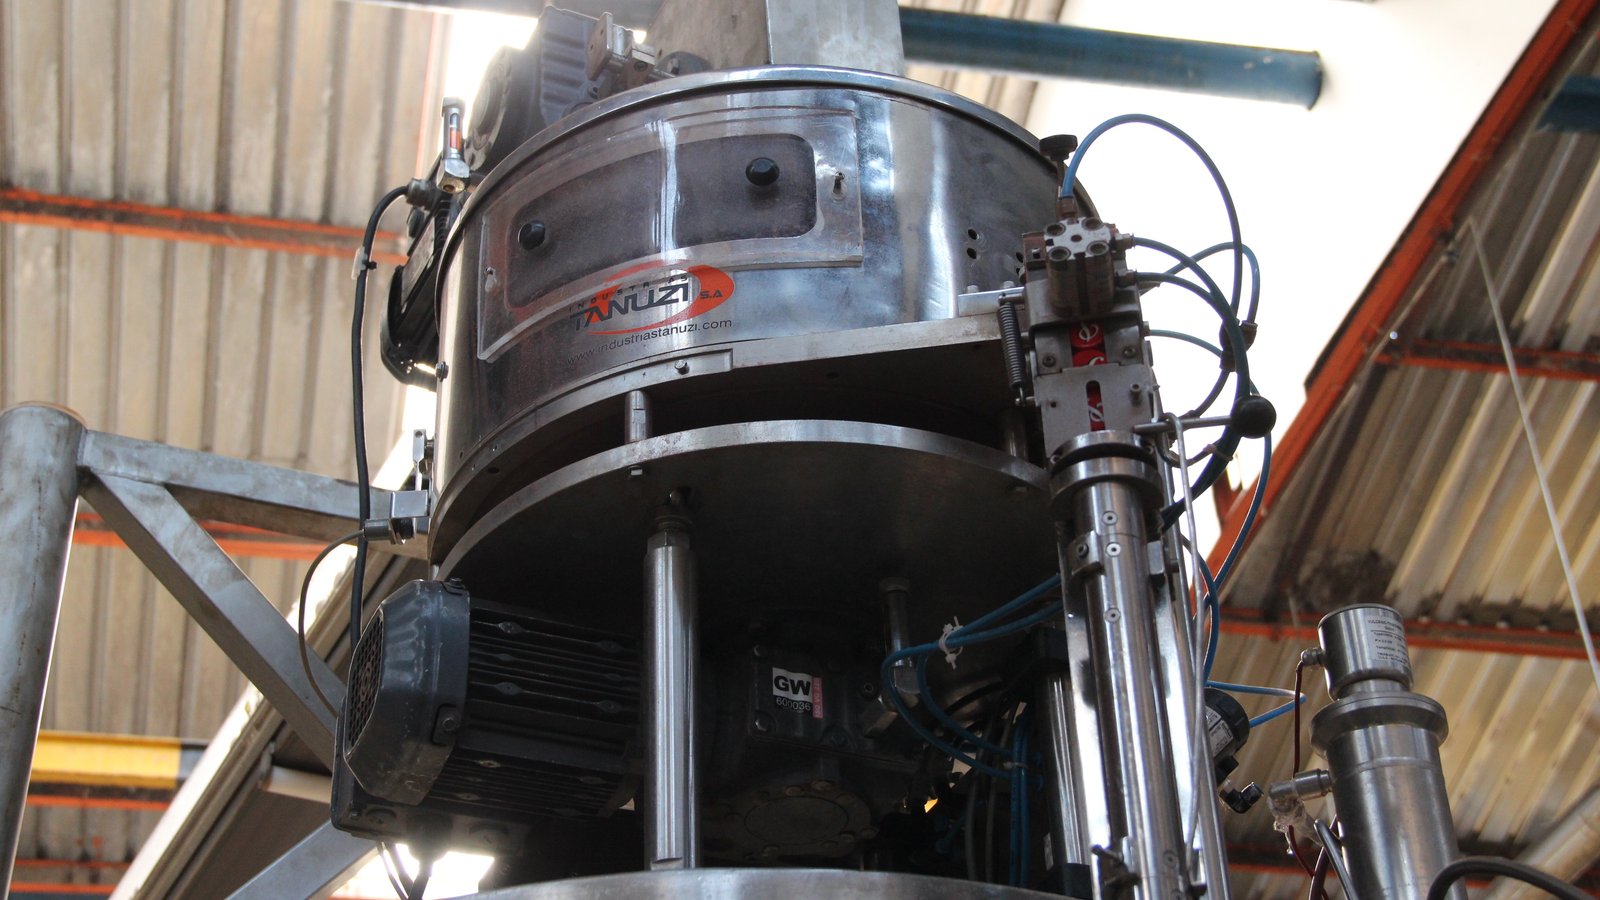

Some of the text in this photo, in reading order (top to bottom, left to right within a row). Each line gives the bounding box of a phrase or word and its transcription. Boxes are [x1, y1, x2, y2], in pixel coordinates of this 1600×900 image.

[569, 275, 688, 312] INDUSTRAS
[570, 282, 689, 331] TANUZI
[773, 675, 811, 696] GW
